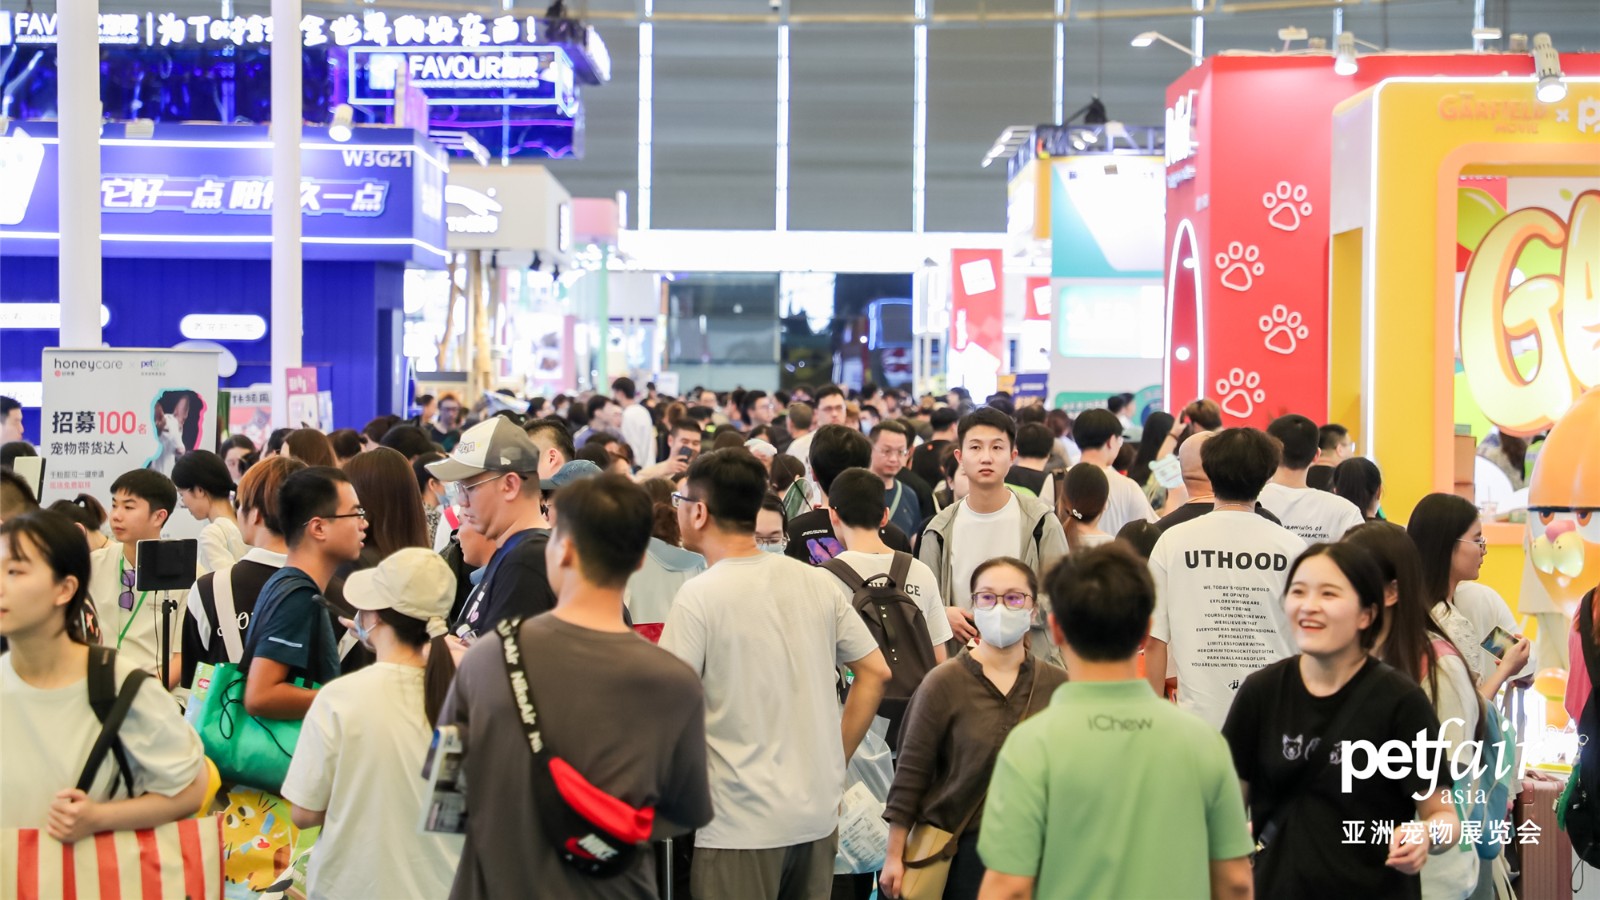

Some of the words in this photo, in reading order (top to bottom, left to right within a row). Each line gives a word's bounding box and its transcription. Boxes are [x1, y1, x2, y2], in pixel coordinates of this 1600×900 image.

[342, 150, 412, 168] W3G21
[229, 178, 385, 212] 陪久一点
[54, 358, 123, 372] honeycare
[52, 410, 147, 435] 招募100名
[50, 441, 129, 456] 宠物带货达人
[1185, 550, 1288, 571] UTHOOD
